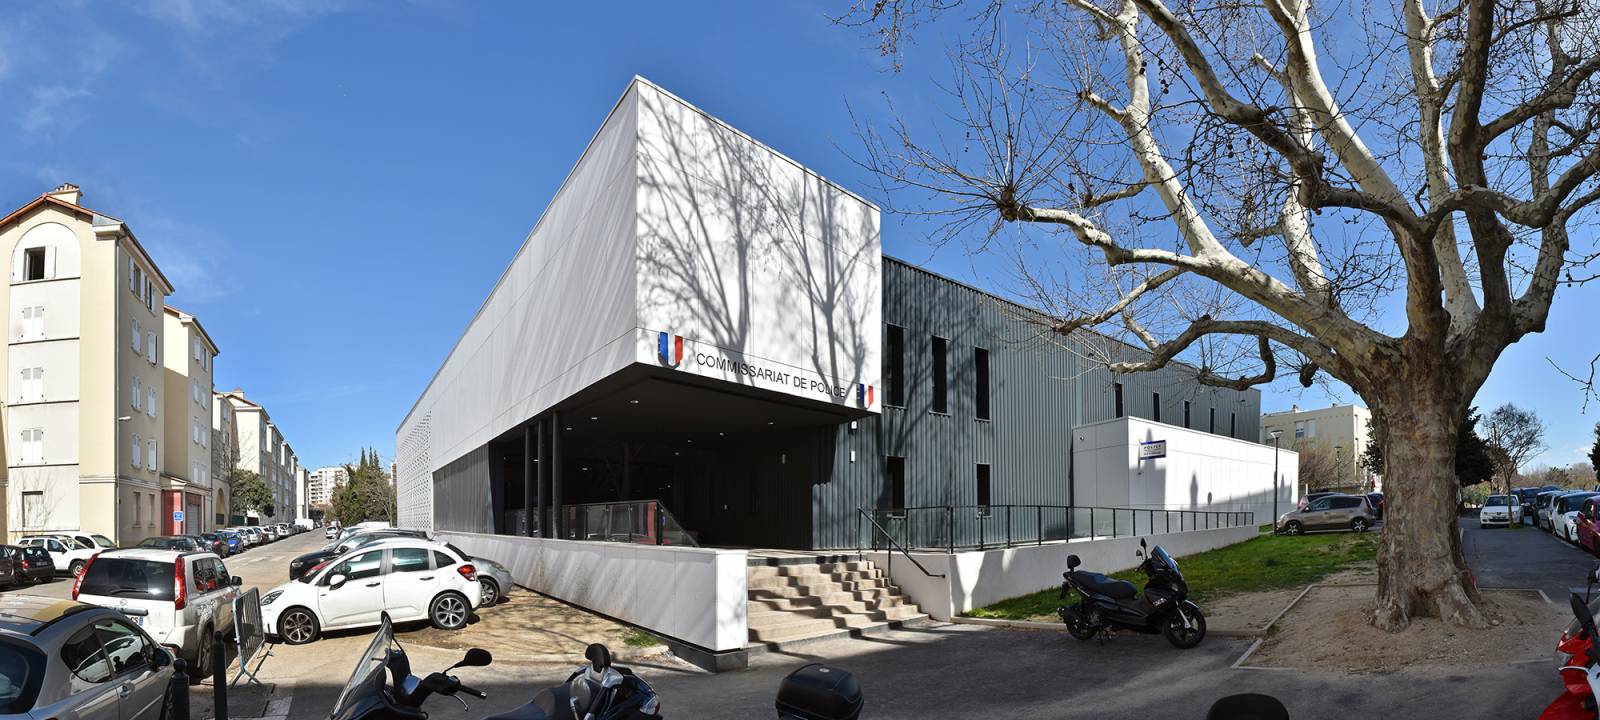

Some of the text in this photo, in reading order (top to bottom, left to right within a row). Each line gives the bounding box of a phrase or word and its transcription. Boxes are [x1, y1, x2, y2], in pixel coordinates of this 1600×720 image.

[697, 353, 846, 398] COMMISSARIAT DE POLICE
